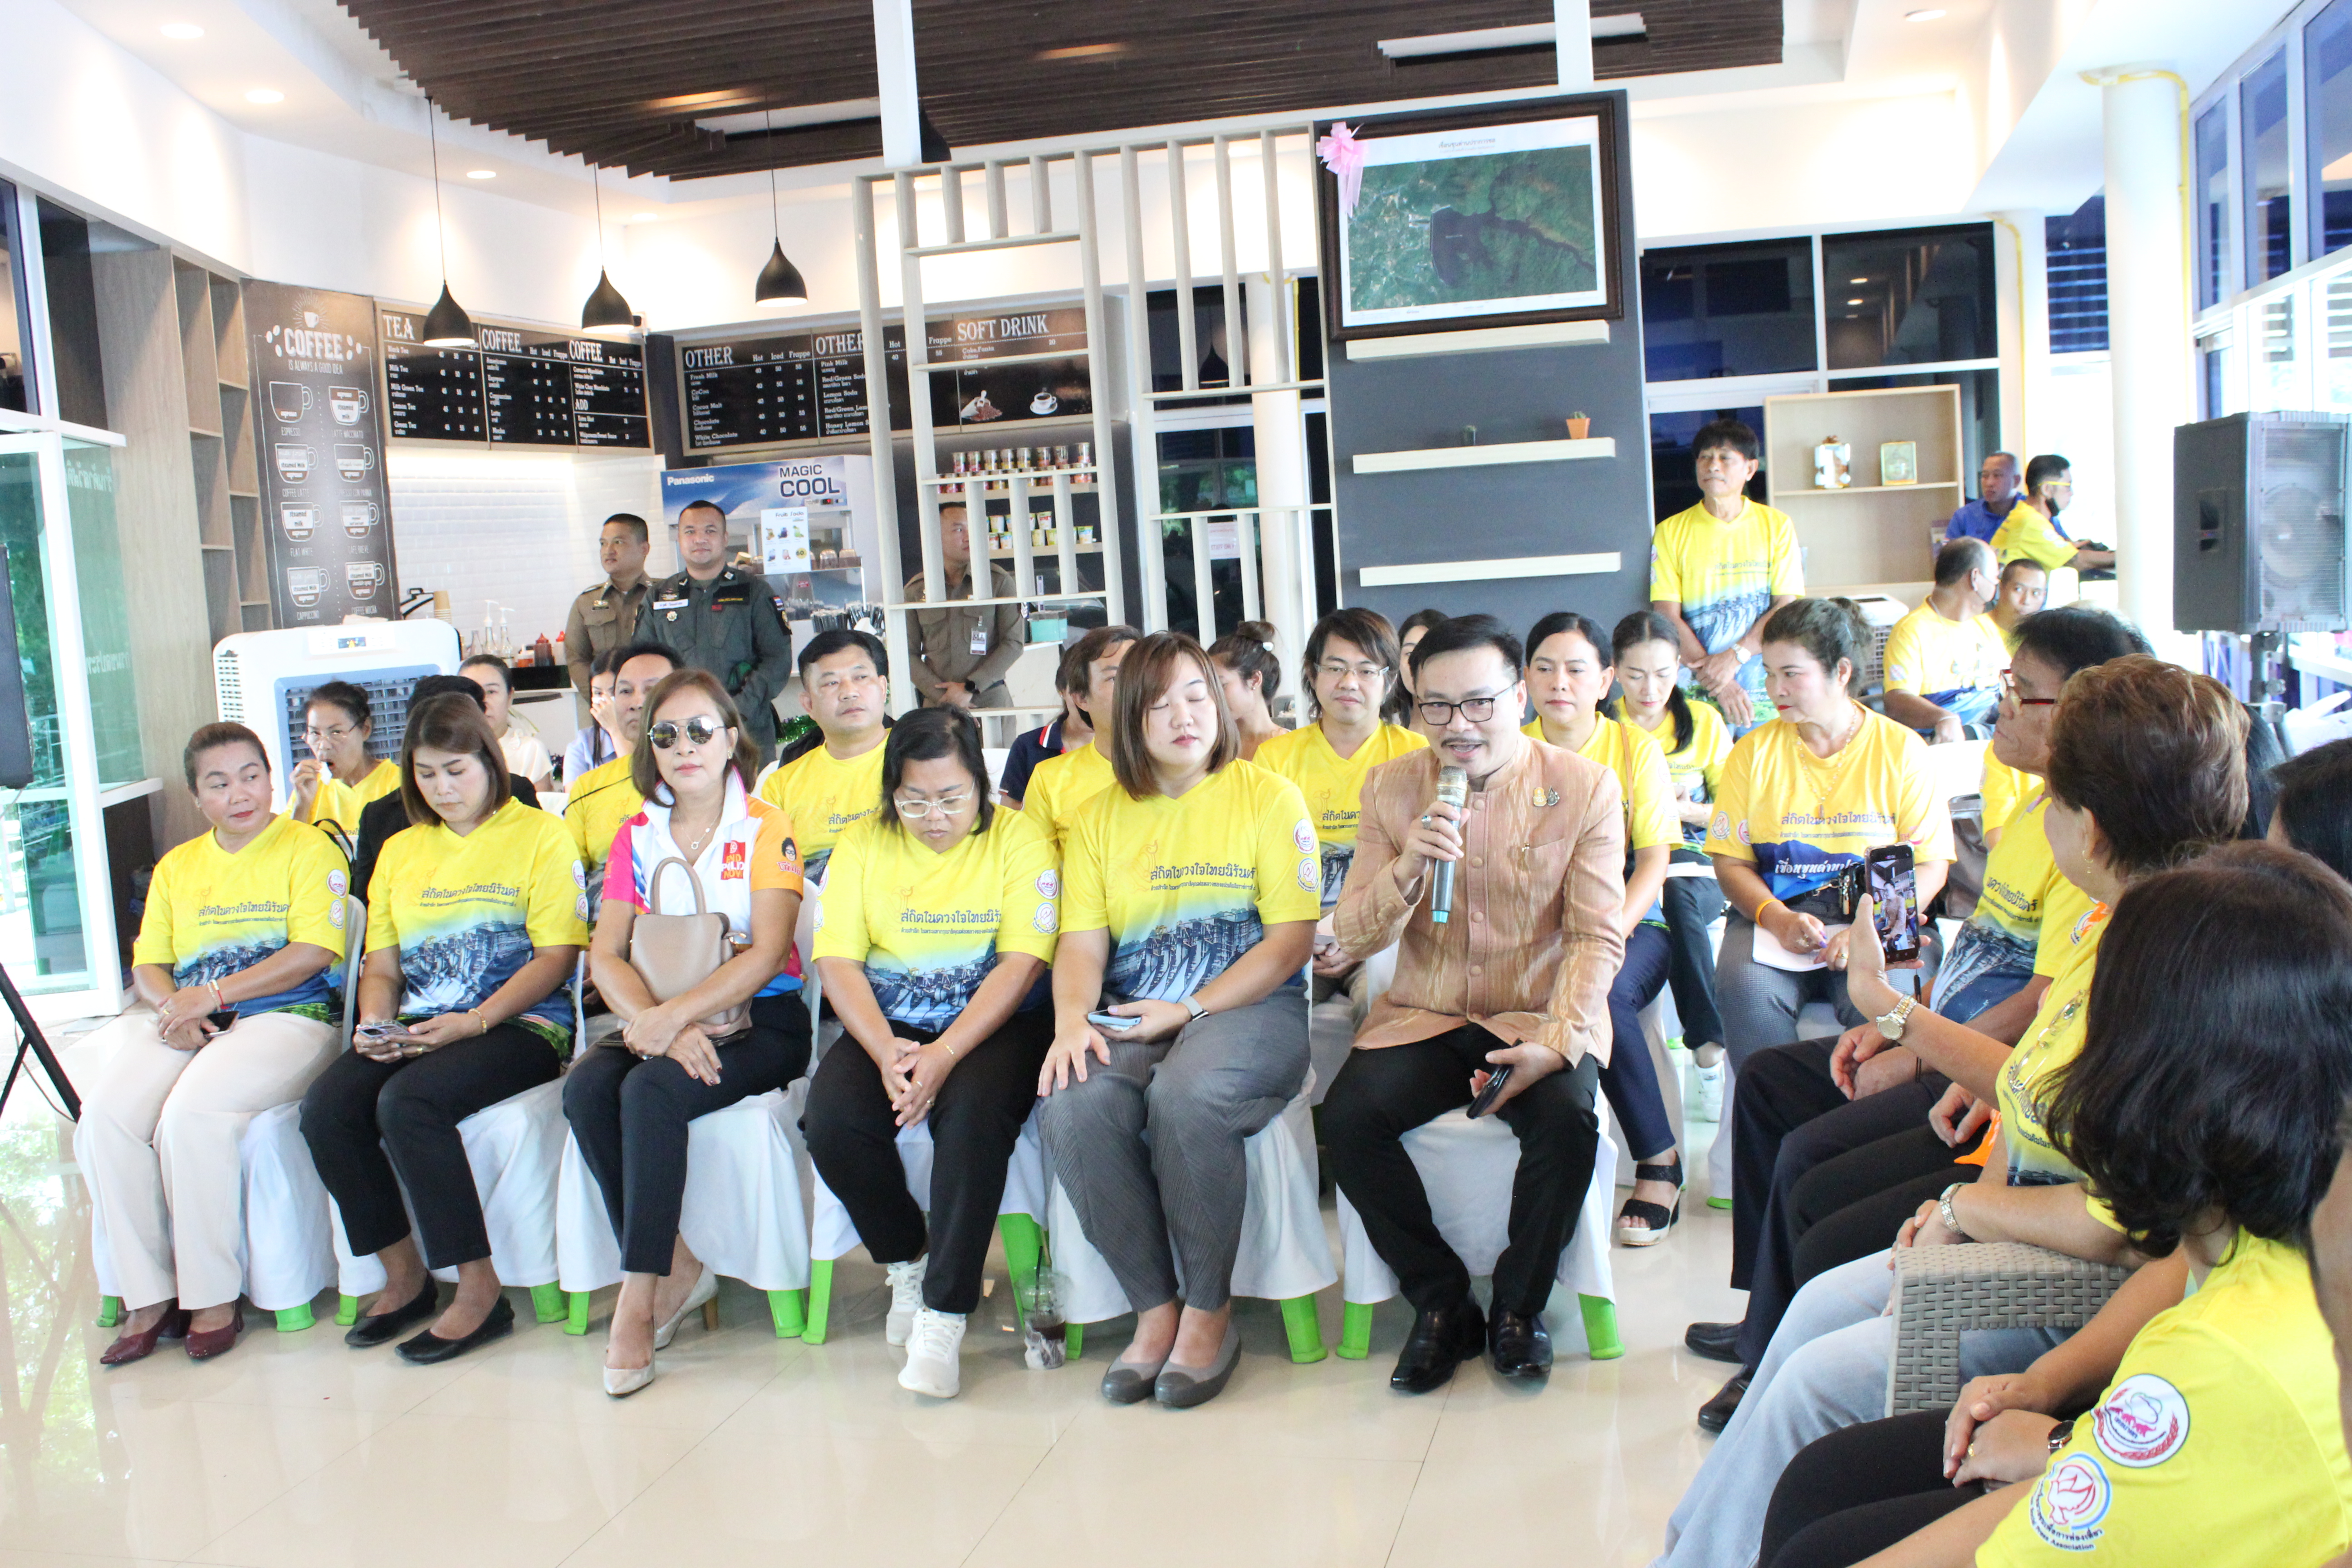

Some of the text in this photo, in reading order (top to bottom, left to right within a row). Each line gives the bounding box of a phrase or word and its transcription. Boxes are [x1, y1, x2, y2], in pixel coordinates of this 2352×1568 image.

[382, 315, 415, 340] TEA
[957, 314, 1049, 342] SOFT DRINK
[284, 328, 344, 361] COFFEE
[482, 328, 522, 353] COFFEE
[928, 336, 952, 344] Frappe
[569, 340, 603, 363] COFFEE
[685, 346, 734, 368] OTHER
[789, 351, 811, 359] Frappe
[289, 359, 294, 371] IS
[295, 360, 314, 372] ALWAYS
[319, 362, 332, 374] GOOD
[332, 363, 343, 375] IDEA
[575, 399, 588, 411] ADD
[666, 473, 714, 486] Panasonic
[779, 465, 823, 478] MAGIC
[780, 477, 840, 498] COOL
[726, 854, 742, 863] END
[2051, 1539, 2095, 1550] Association
